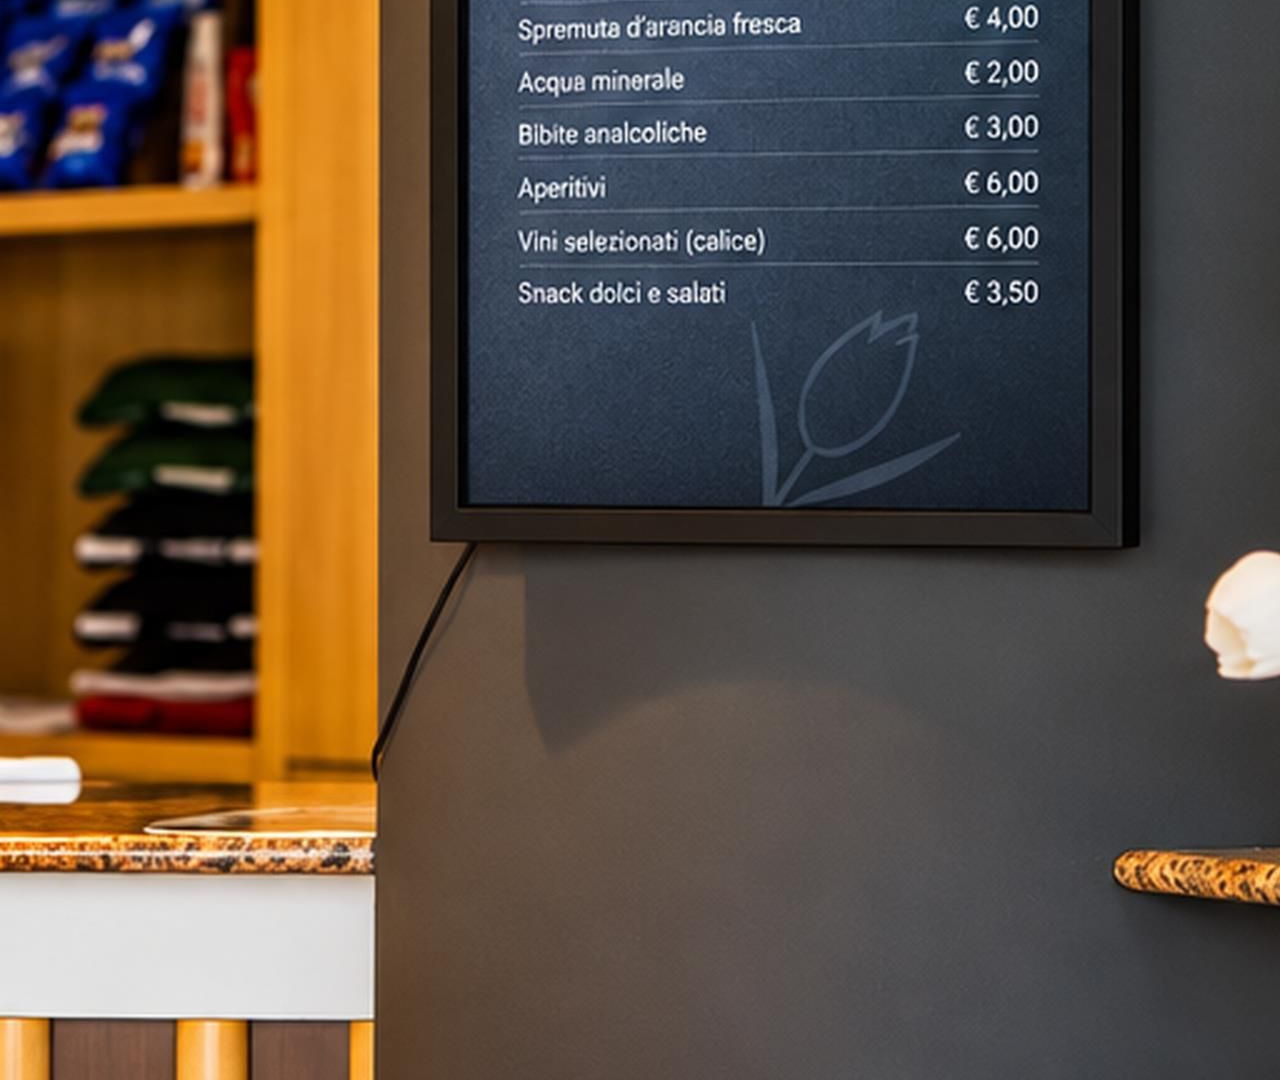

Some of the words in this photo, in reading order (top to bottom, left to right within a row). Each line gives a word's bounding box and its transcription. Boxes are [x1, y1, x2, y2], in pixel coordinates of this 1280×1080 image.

[519, 19, 621, 46] Spremuta
[733, 12, 802, 35] fresca
[964, 6, 981, 30] €
[986, 5, 1039, 33] 4,00
[518, 71, 586, 97] Acqua
[592, 67, 685, 92] minerale
[964, 60, 981, 85] €
[986, 60, 1039, 88] 2,00
[519, 123, 579, 146] Bibite
[584, 120, 708, 144] analcoliche
[964, 115, 981, 139] €
[986, 115, 1039, 142] 3,00
[518, 176, 606, 204] Aperitivi
[964, 170, 981, 195] €
[986, 170, 1039, 198] 6,00
[518, 230, 558, 252] Vini
[564, 229, 679, 253] selezionati
[686, 228, 766, 256] (calice)
[964, 226, 981, 251] €
[986, 226, 1039, 254] 6,00
[519, 281, 584, 305] Snack
[589, 281, 642, 304] dolci
[647, 287, 662, 304] e
[667, 280, 726, 304] salati
[964, 280, 981, 304] €
[986, 280, 1039, 307] 3,50
